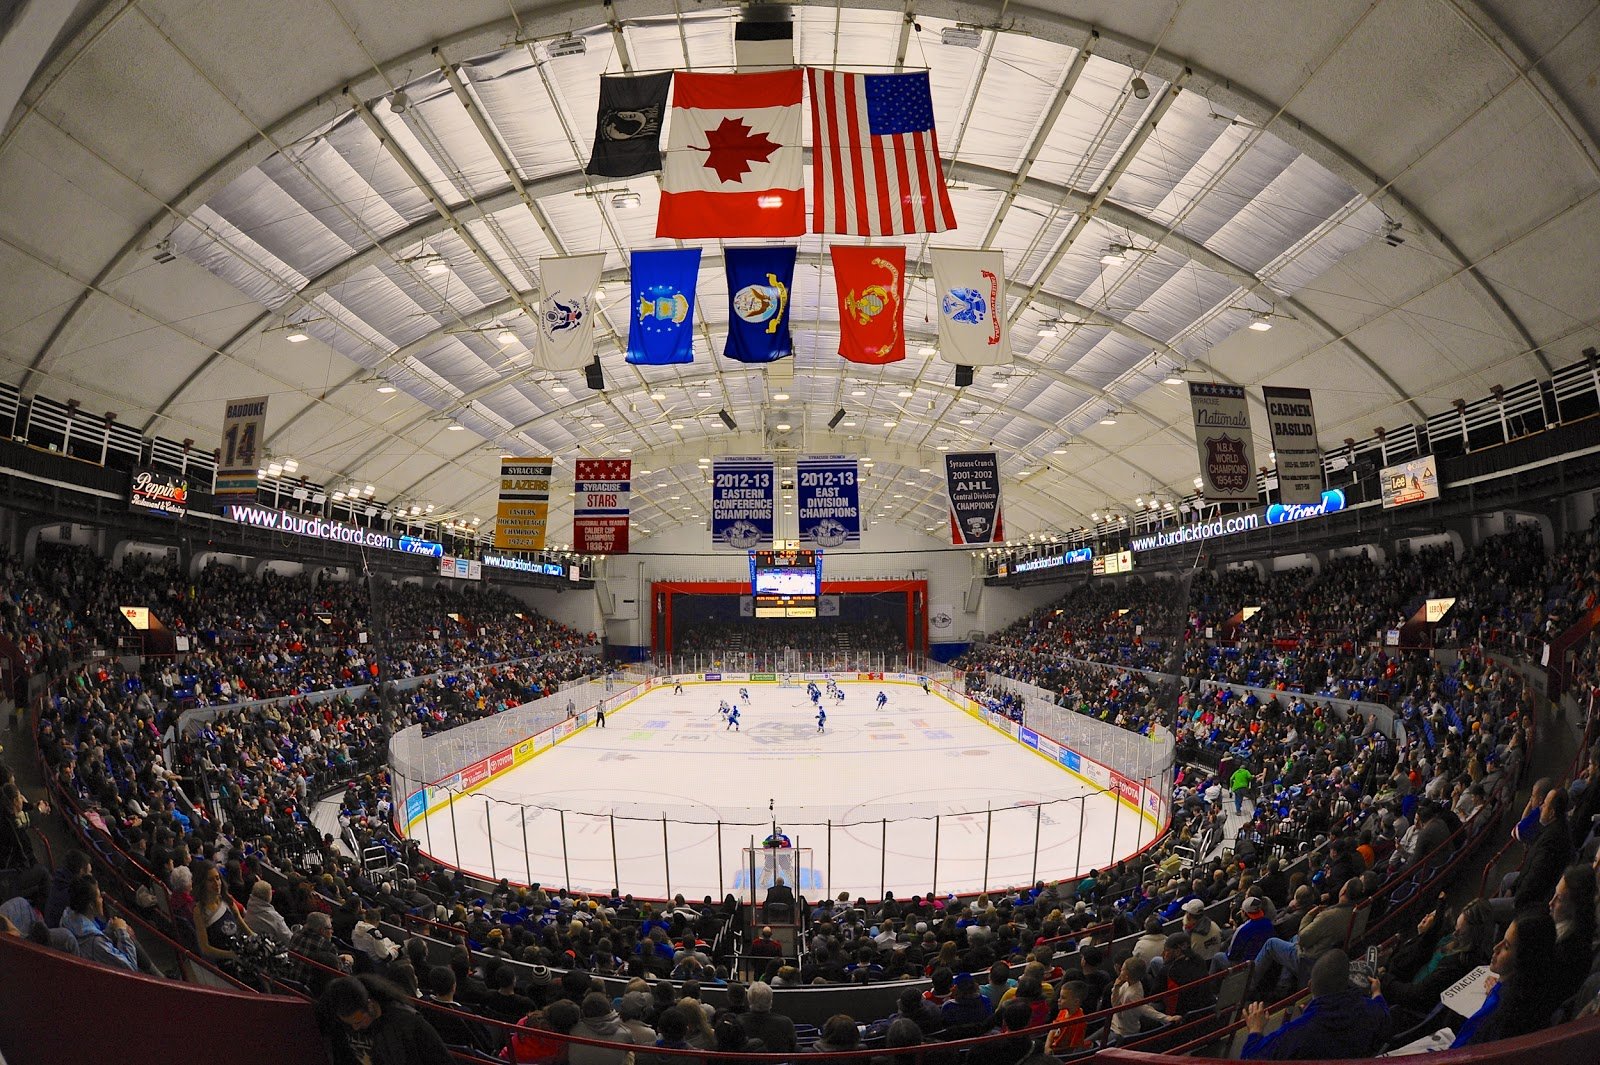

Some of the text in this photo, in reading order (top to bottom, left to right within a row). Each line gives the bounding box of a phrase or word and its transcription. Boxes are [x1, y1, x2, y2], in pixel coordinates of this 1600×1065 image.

[1270, 402, 1312, 417] CARMEN
[1198, 408, 1247, 426] Nationals
[1274, 422, 1313, 436] BASILIO
[224, 422, 258, 467] 14
[1216, 442, 1236, 452] N.B.A.
[950, 460, 974, 468] Syracuse
[1215, 454, 1238, 464] WORLD
[1210, 464, 1247, 474] CHAMPIONS
[716, 474, 769, 487] 2012-13
[801, 472, 854, 486] 2012-13
[953, 471, 992, 480] 2001-2002
[1216, 476, 1242, 485] 1954-55
[502, 480, 548, 490] BLAZERS
[956, 482, 992, 490] AHL
[1392, 476, 1405, 488] Lee
[583, 484, 621, 492] SYRACUSE
[816, 487, 839, 497] EAST
[722, 489, 764, 498] EASTERN
[587, 494, 617, 508] STARS
[714, 499, 772, 509] CONFERENCE
[807, 498, 848, 507] DIVISION
[956, 502, 994, 510] CHAMPIONS
[714, 510, 772, 519] CHAMPIONS
[800, 508, 856, 518] CHAMPIONS
[231, 504, 393, 549] www.burdickford.com
[1132, 512, 1258, 552] www.burdickford.com
[406, 541, 436, 557] Ford
[586, 542, 612, 551] 1936-37
[484, 554, 543, 574] www.burdickford.com
[497, 754, 512, 767] TOYOTA
[1120, 781, 1138, 800] TOYOTA
[1445, 968, 1486, 998] SYRACUSE
